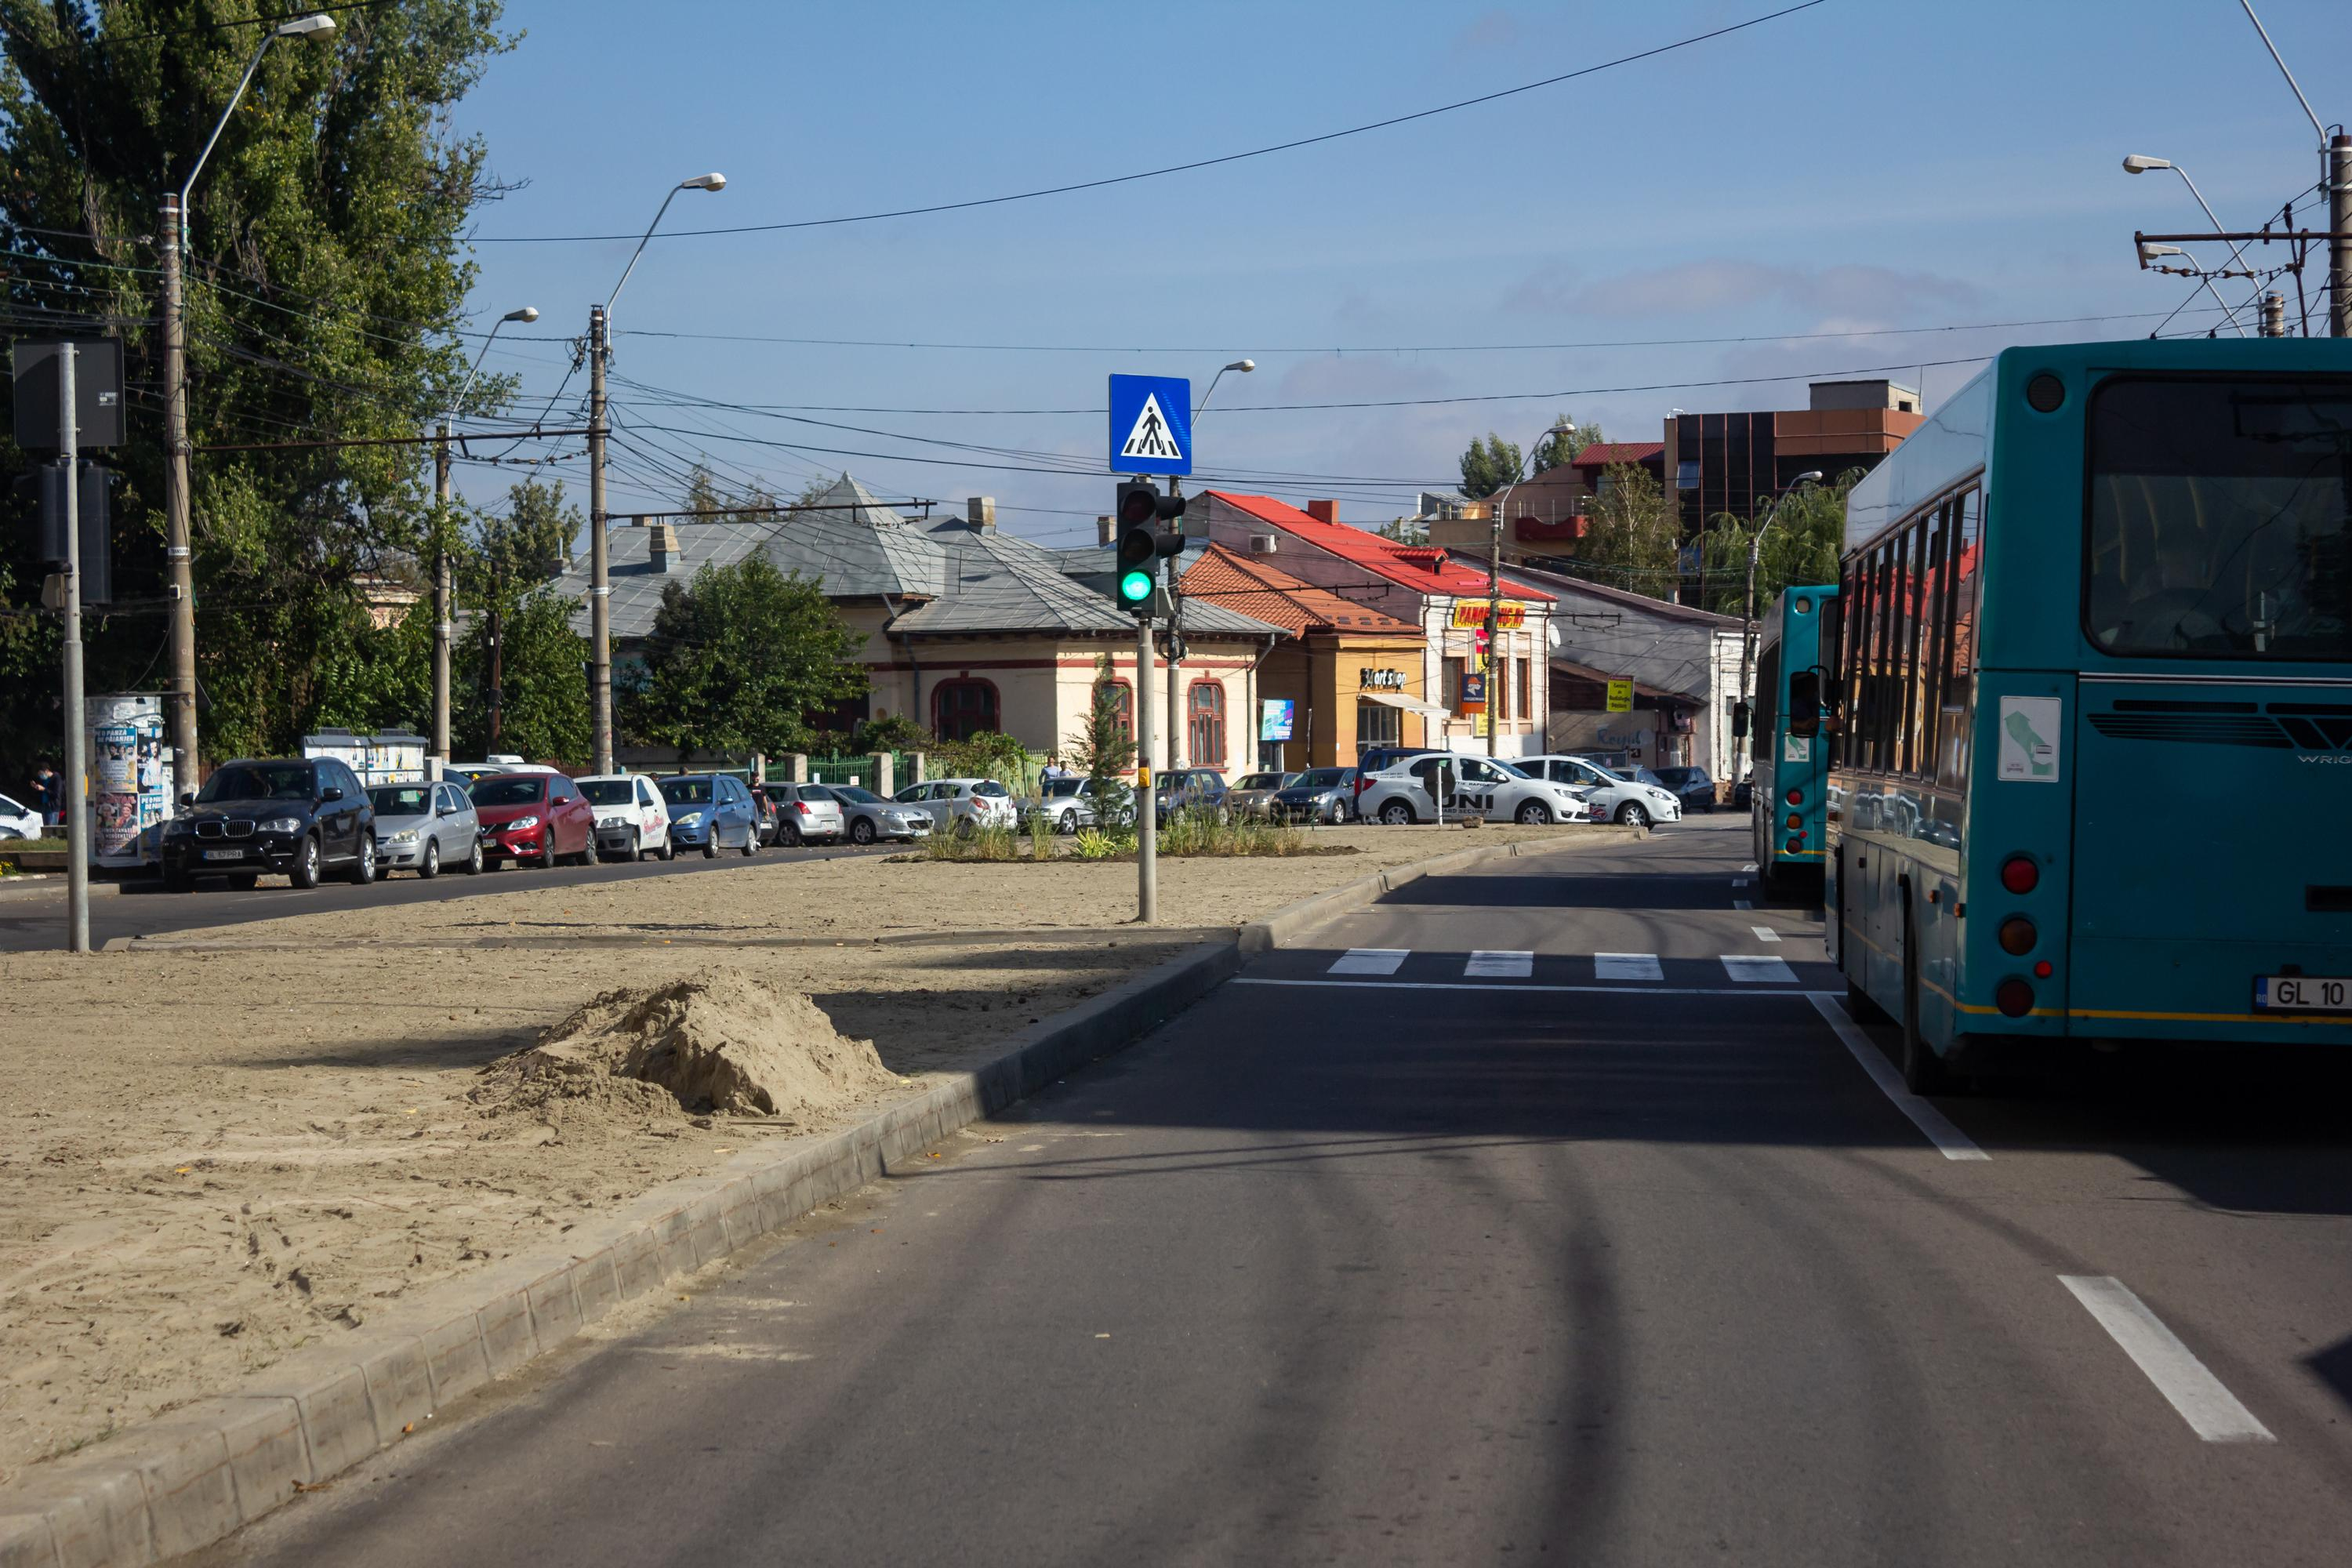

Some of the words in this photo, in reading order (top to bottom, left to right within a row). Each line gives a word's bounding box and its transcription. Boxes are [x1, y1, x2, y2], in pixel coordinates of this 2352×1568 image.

[2297, 755, 2352, 764] WRIG
[1433, 793, 1494, 809] UNI
[2256, 993, 2267, 1004] RO
[2278, 982, 2310, 1004] GL
[2322, 982, 2343, 1005] 10
